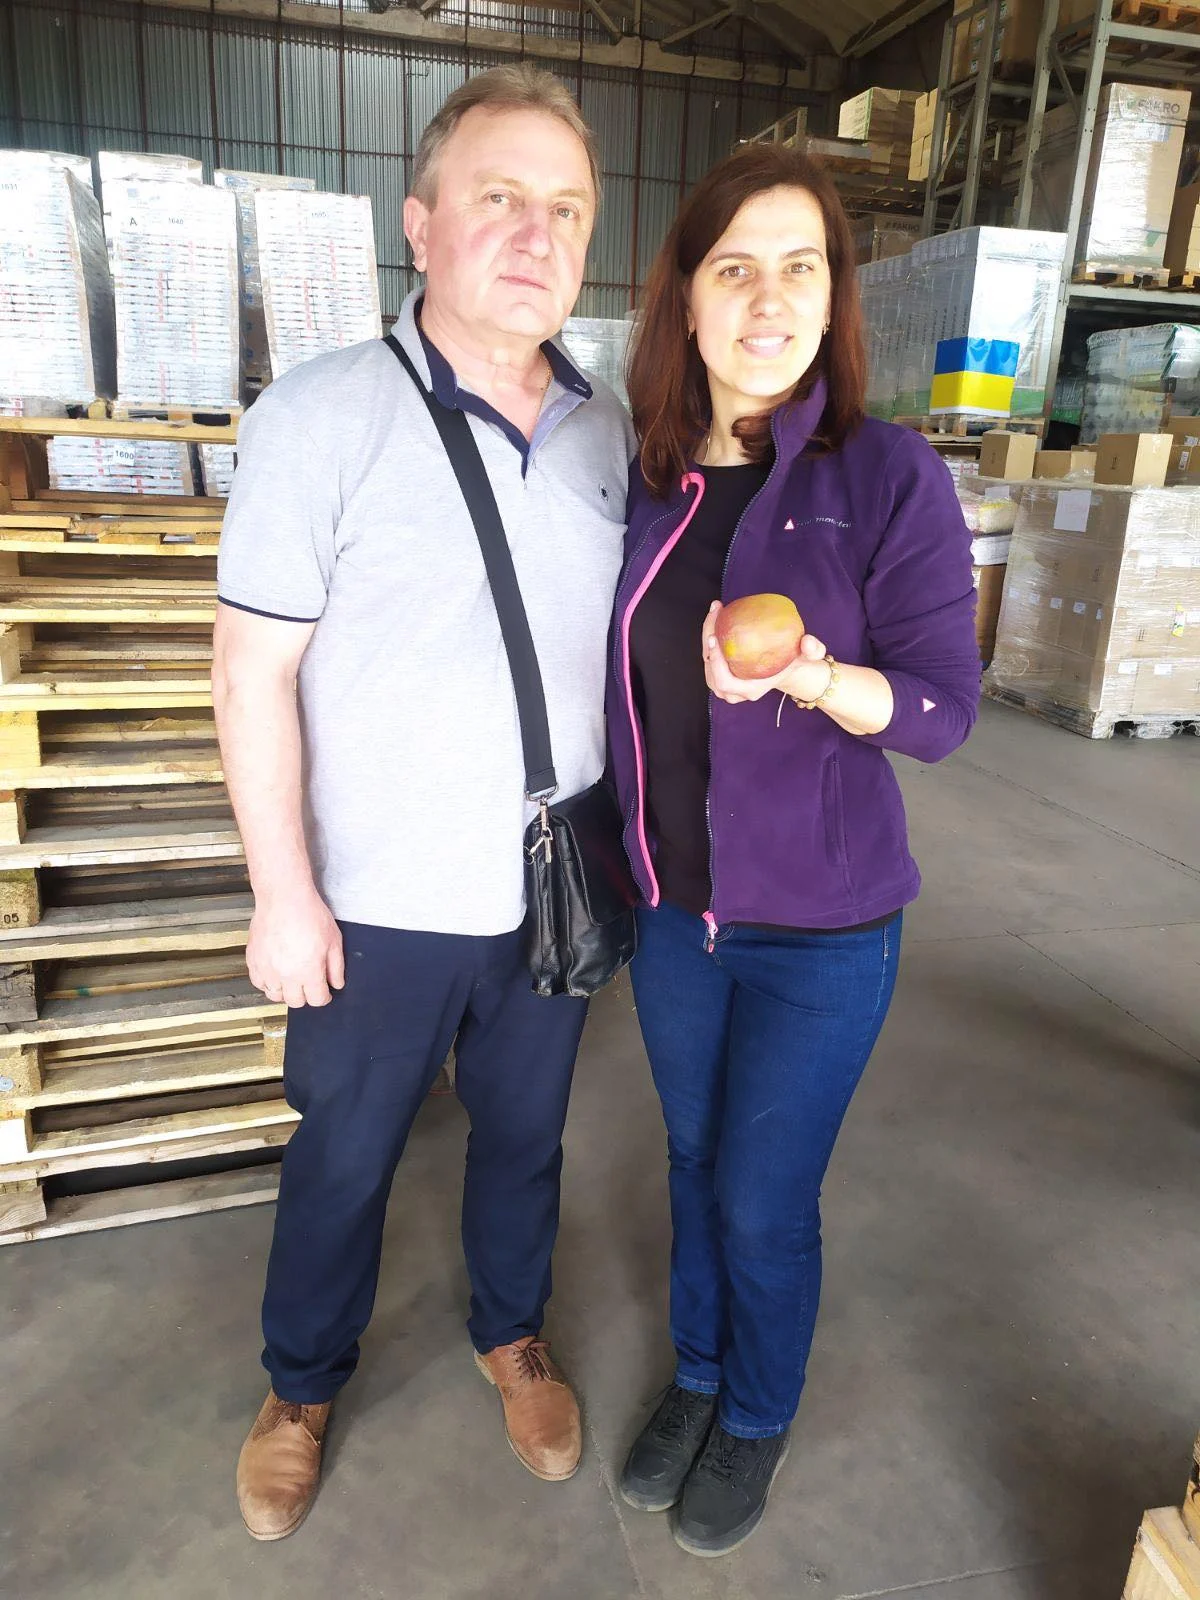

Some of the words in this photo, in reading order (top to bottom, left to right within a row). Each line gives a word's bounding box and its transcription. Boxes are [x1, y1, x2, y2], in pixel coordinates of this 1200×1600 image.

[128, 216, 138, 227] A
[115, 449, 134, 460] 1600
[3, 912, 19, 924] 05
